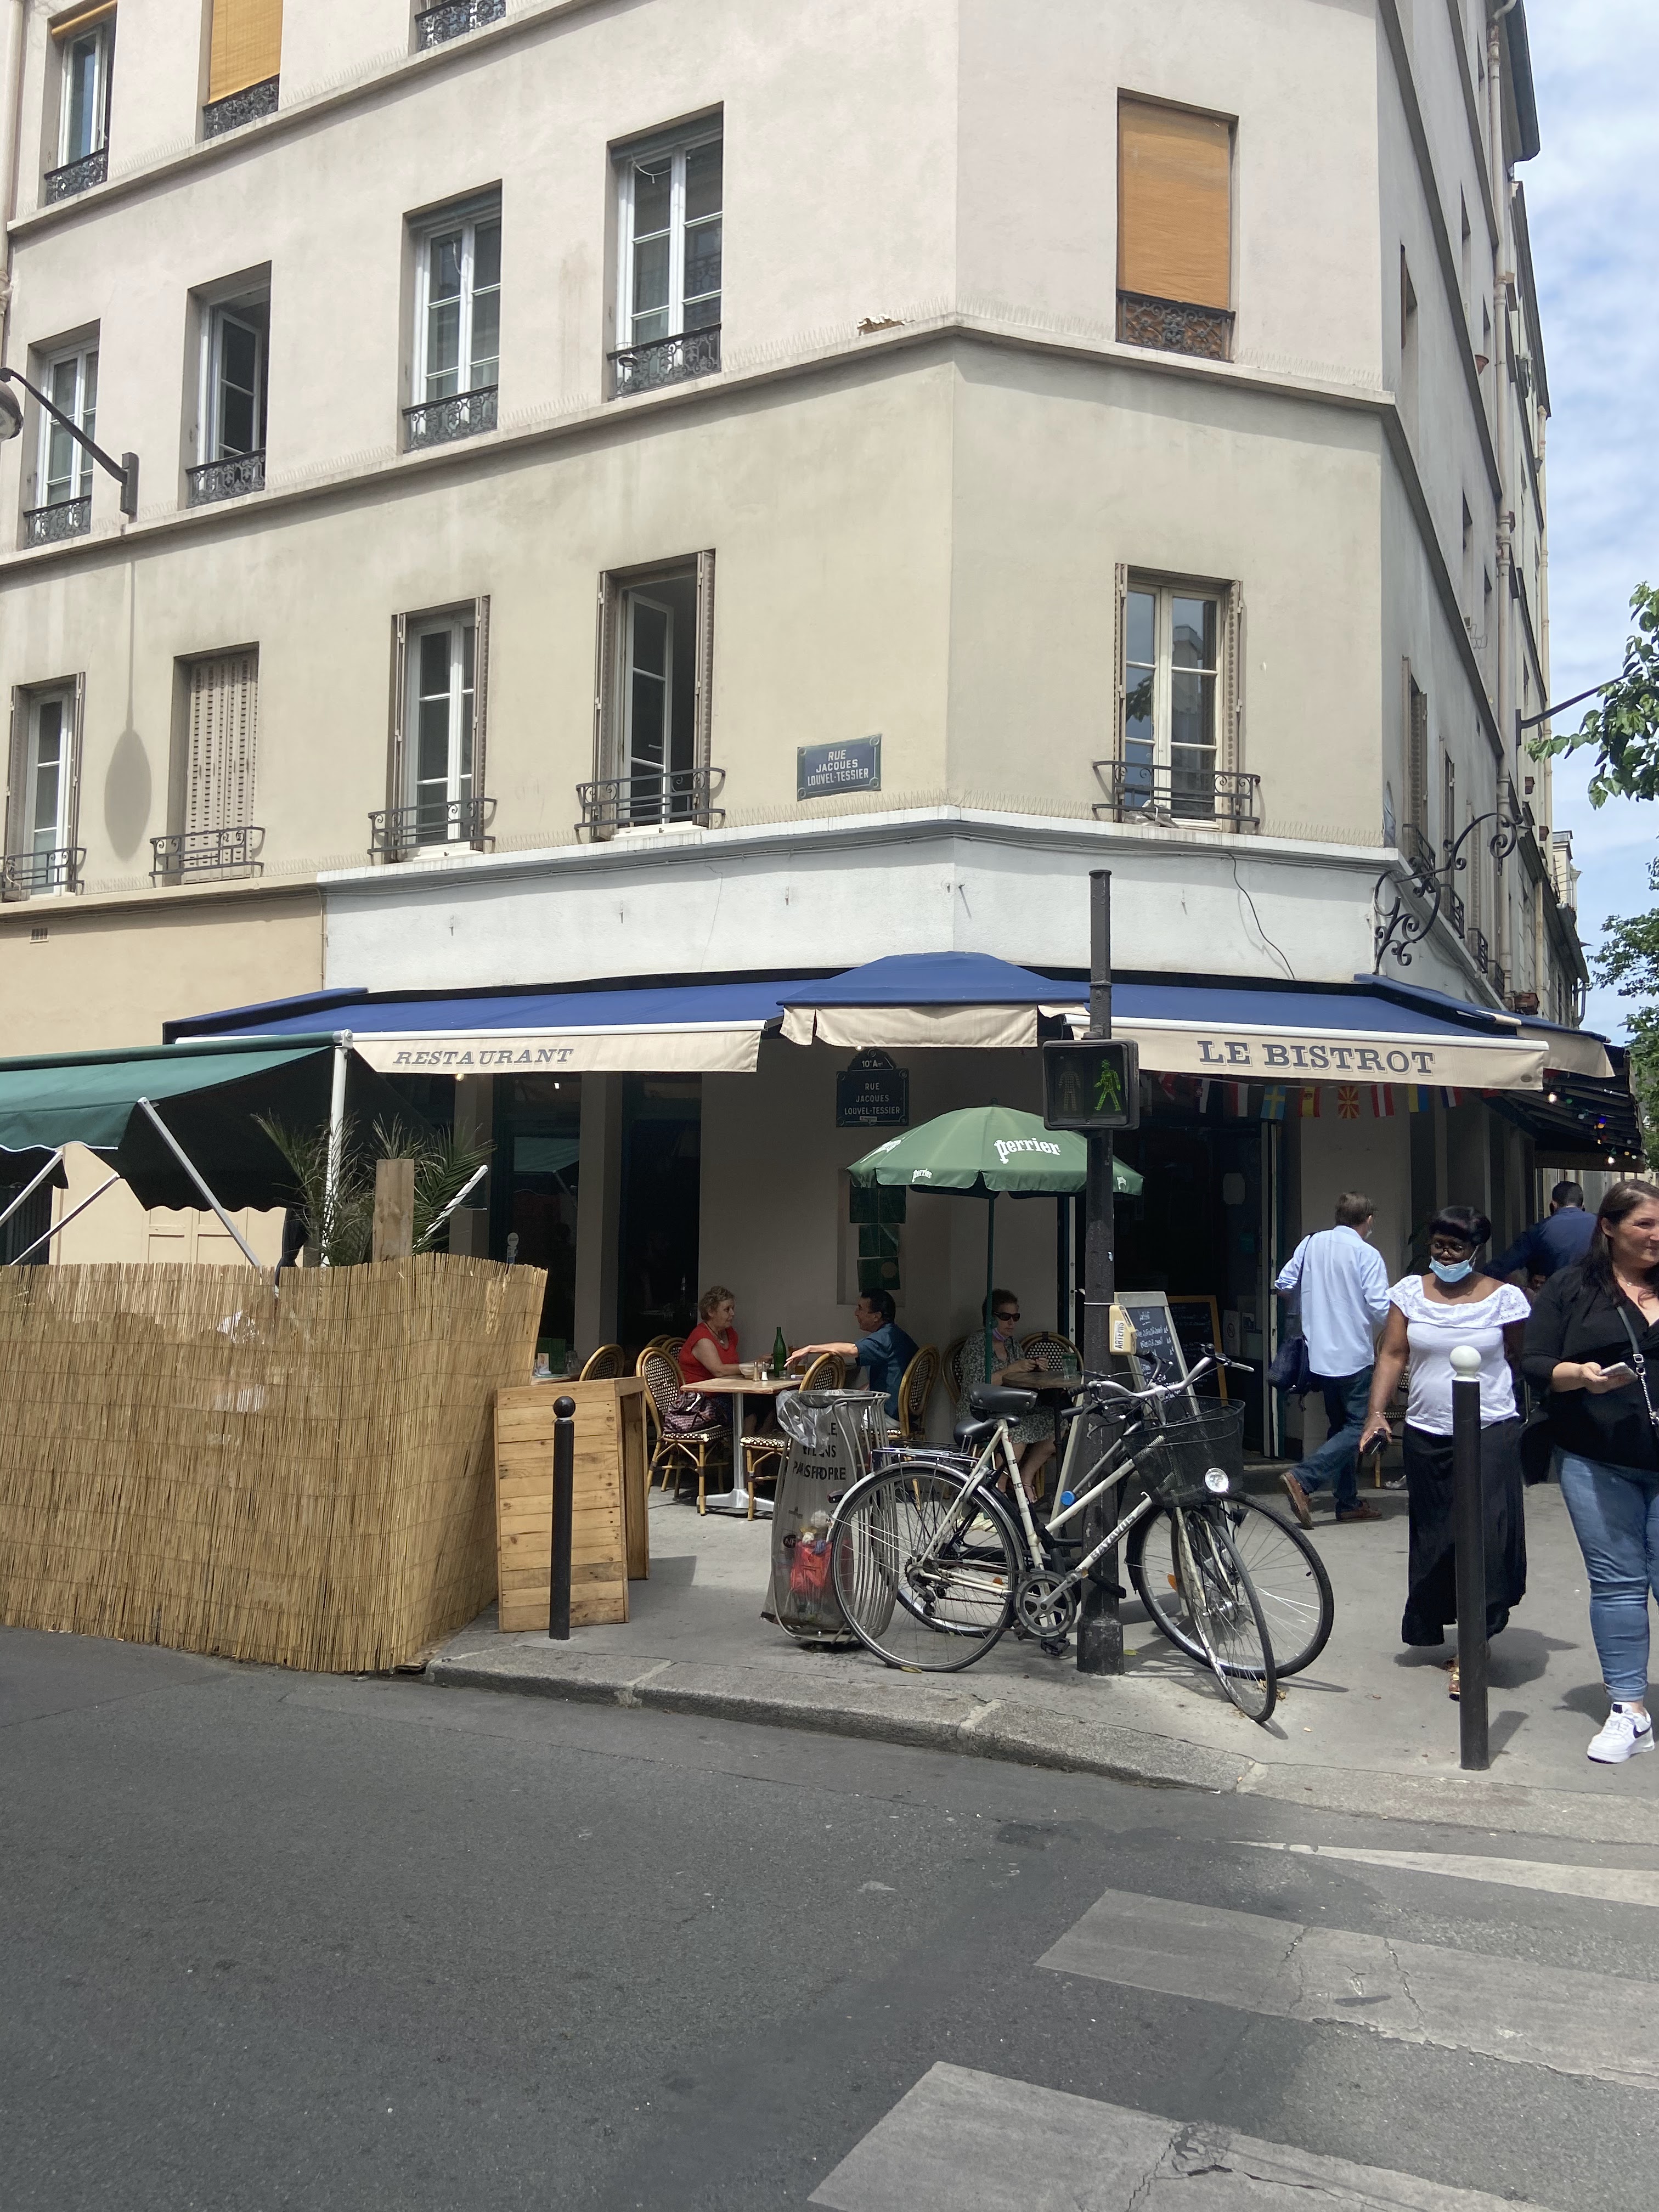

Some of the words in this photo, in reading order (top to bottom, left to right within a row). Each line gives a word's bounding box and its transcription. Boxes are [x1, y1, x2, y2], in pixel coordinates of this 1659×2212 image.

[828, 749, 847, 761] RUE
[816, 759, 858, 773] JACQUES
[807, 768, 869, 786] LOUVEL-TESSIER
[392, 1048, 574, 1066] RESTAURANT
[1197, 1040, 1251, 1066] LE
[1262, 1043, 1435, 1075] BISTROT
[856, 1094, 889, 1103] JACQUES
[844, 1107, 900, 1115] LOUVEL-TESSIER
